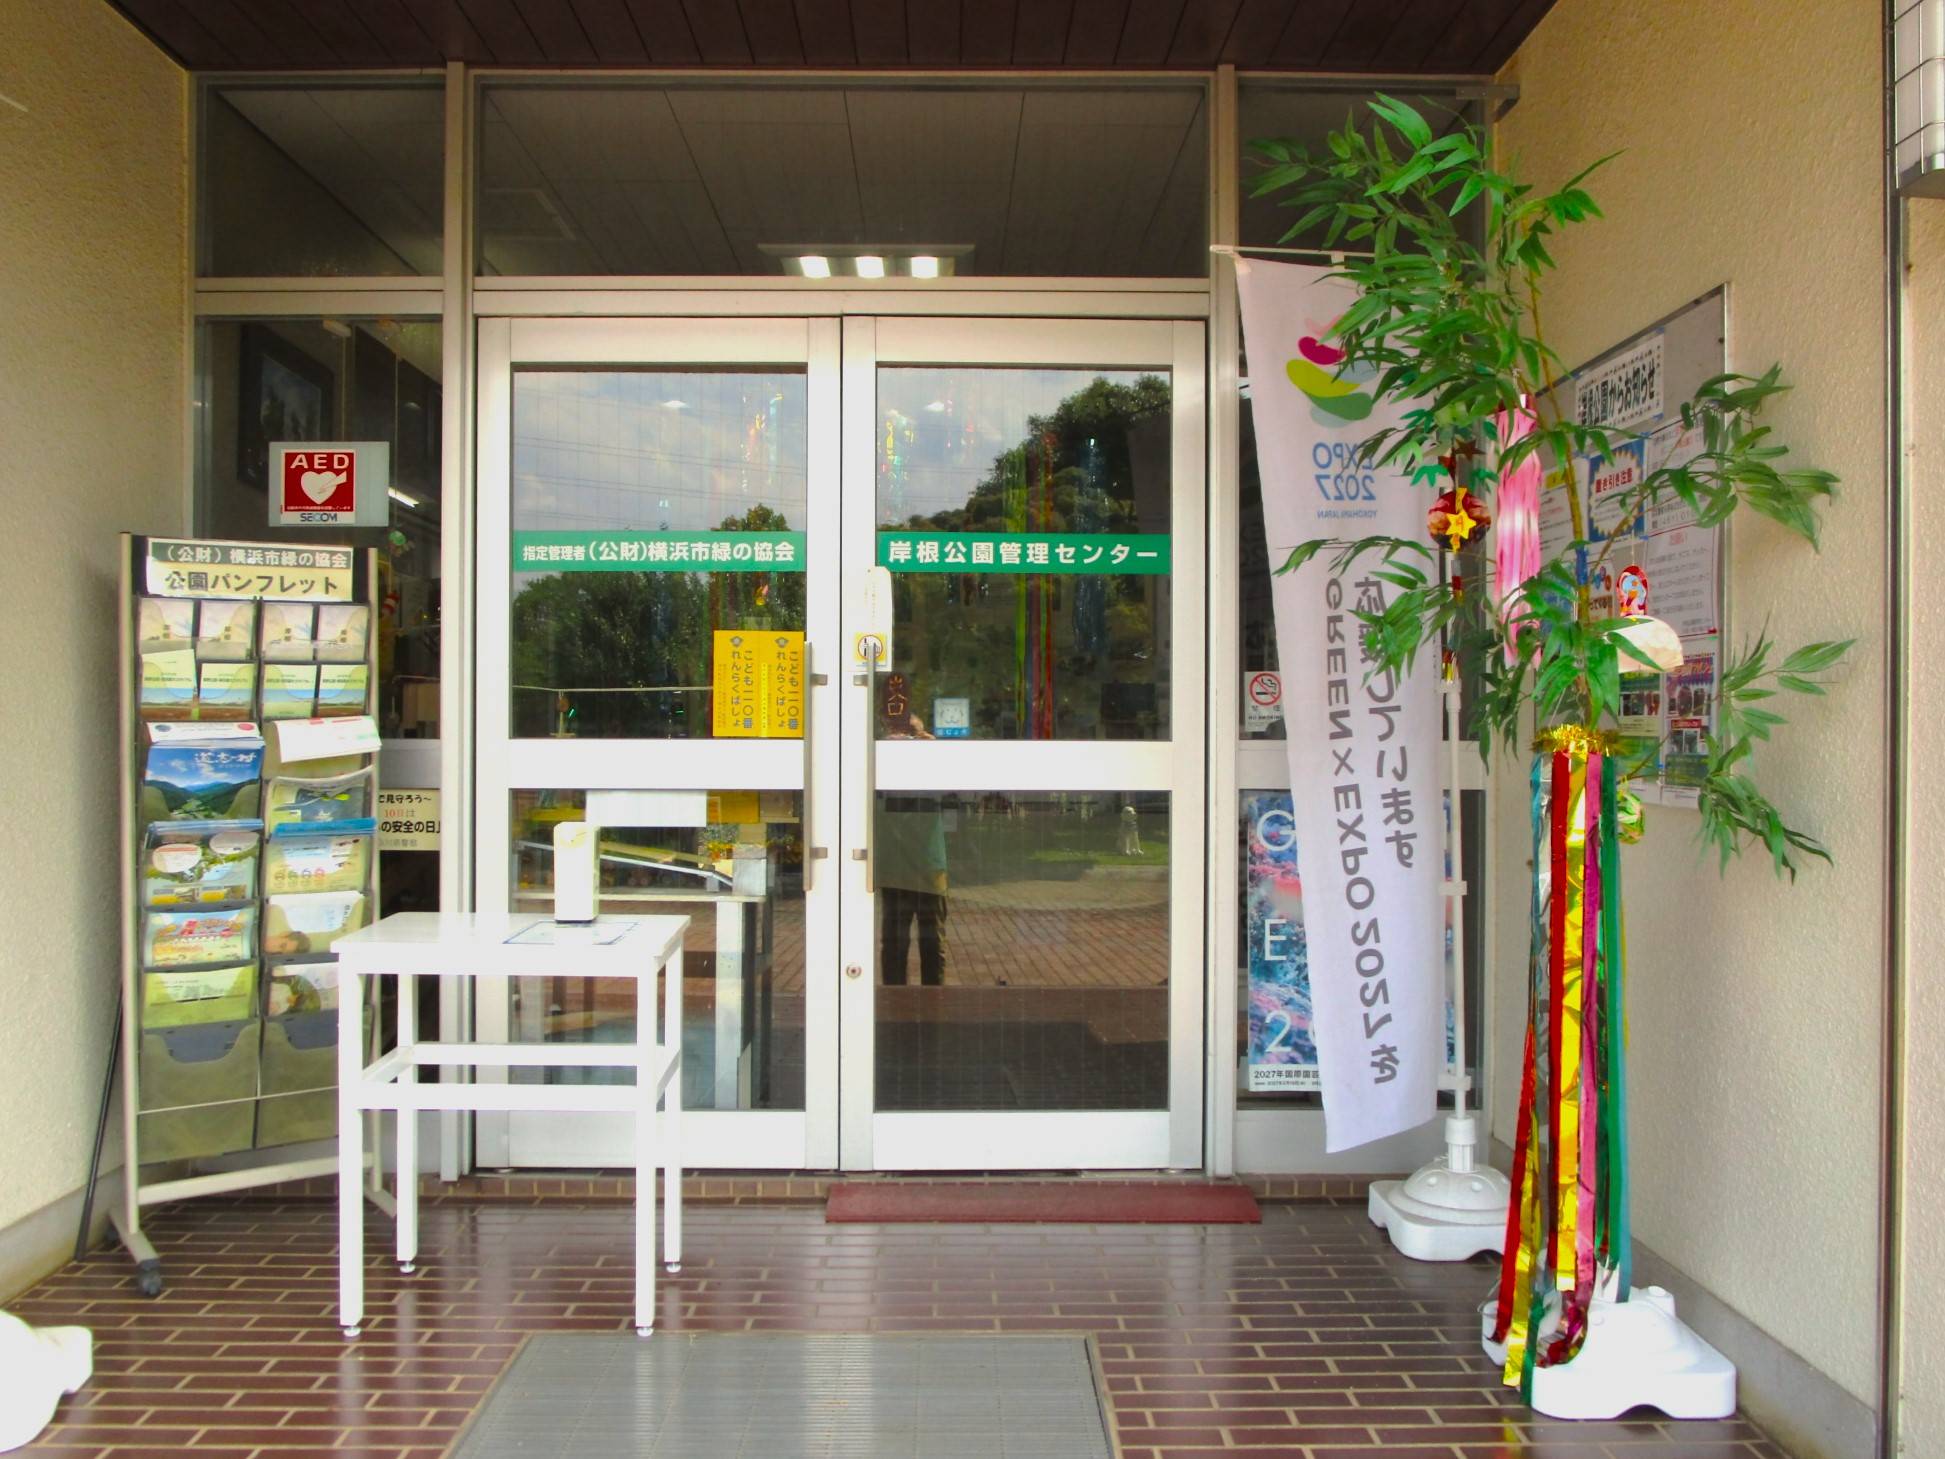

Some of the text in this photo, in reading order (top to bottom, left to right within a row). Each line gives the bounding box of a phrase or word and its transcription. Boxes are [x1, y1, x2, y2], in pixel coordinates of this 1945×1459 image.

[289, 454, 350, 469] AED
[300, 512, 338, 522] SECOM
[888, 541, 1159, 565] 岸根公園管理センター
[164, 570, 339, 594] 公園パンフレット
